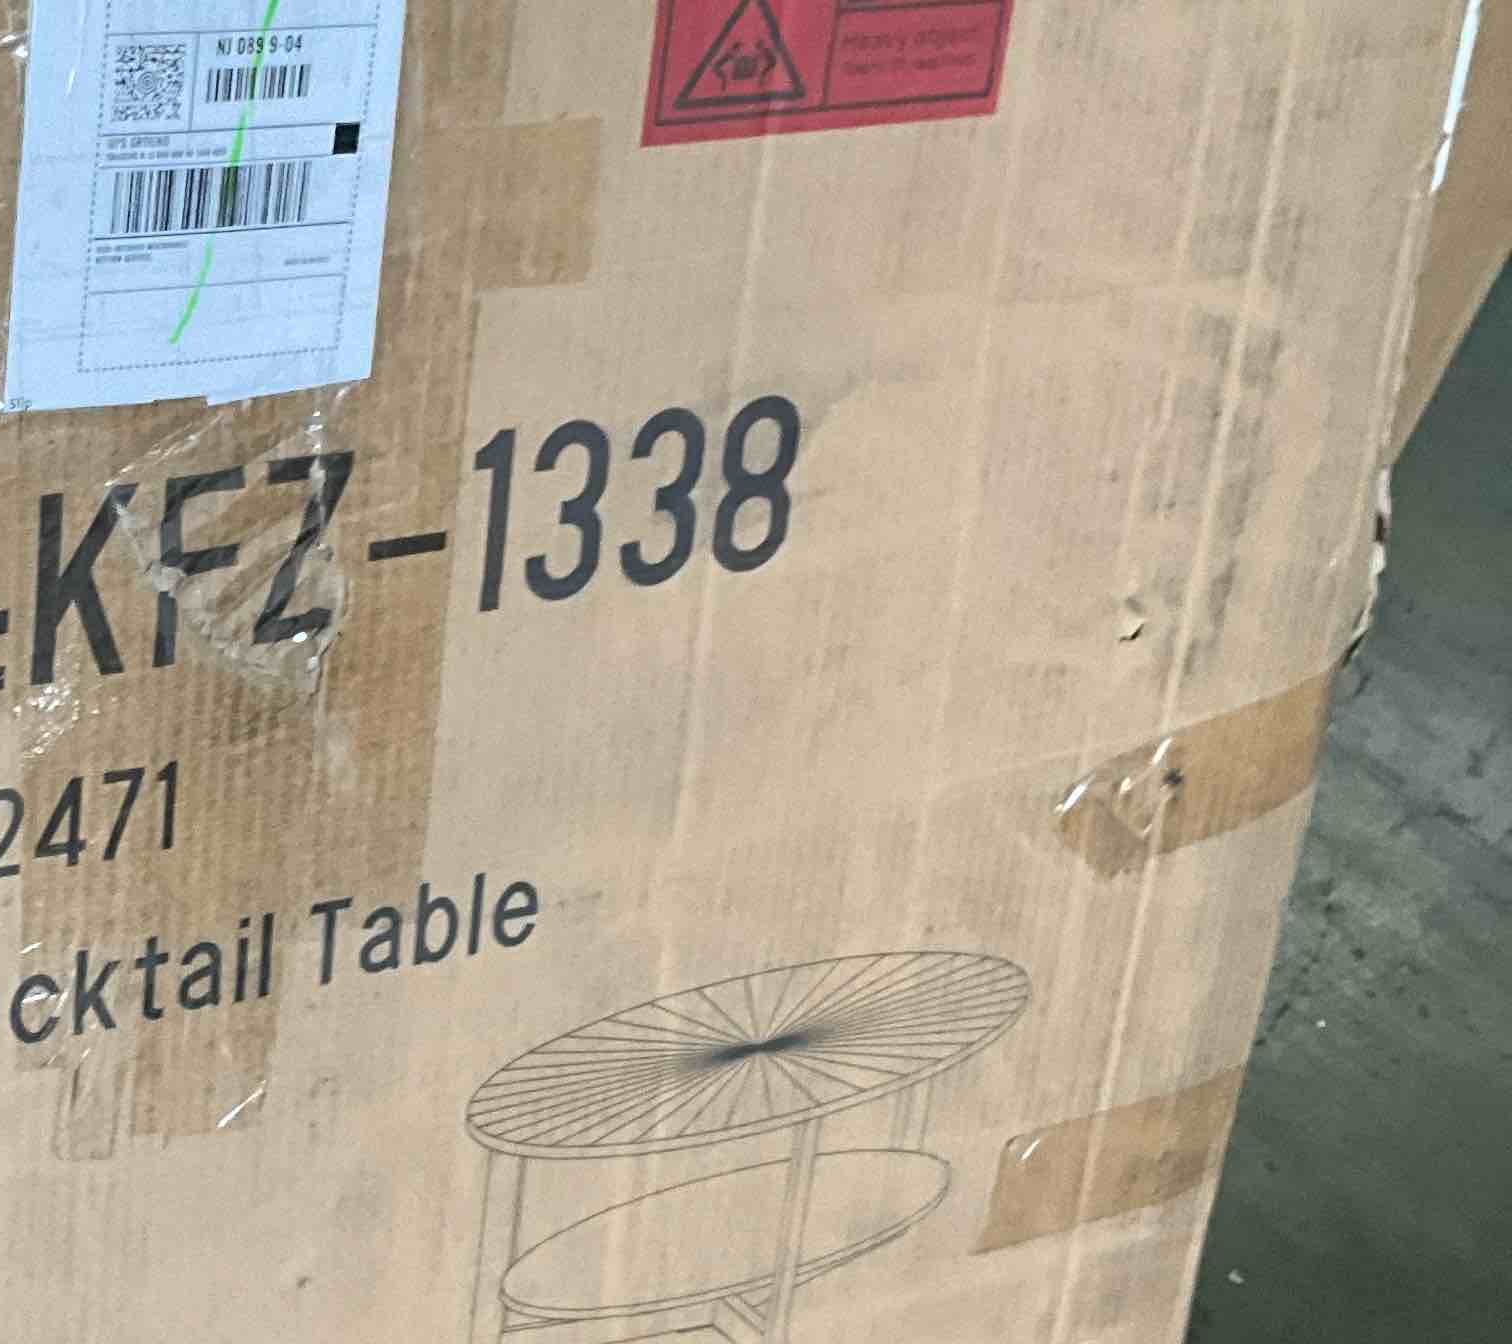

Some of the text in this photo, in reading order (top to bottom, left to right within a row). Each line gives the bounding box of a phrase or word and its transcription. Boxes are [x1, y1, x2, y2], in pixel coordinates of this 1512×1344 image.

[217, 38, 233, 56] NJ
[269, 35, 304, 54] 9-04
[310, 872, 539, 985] Table
